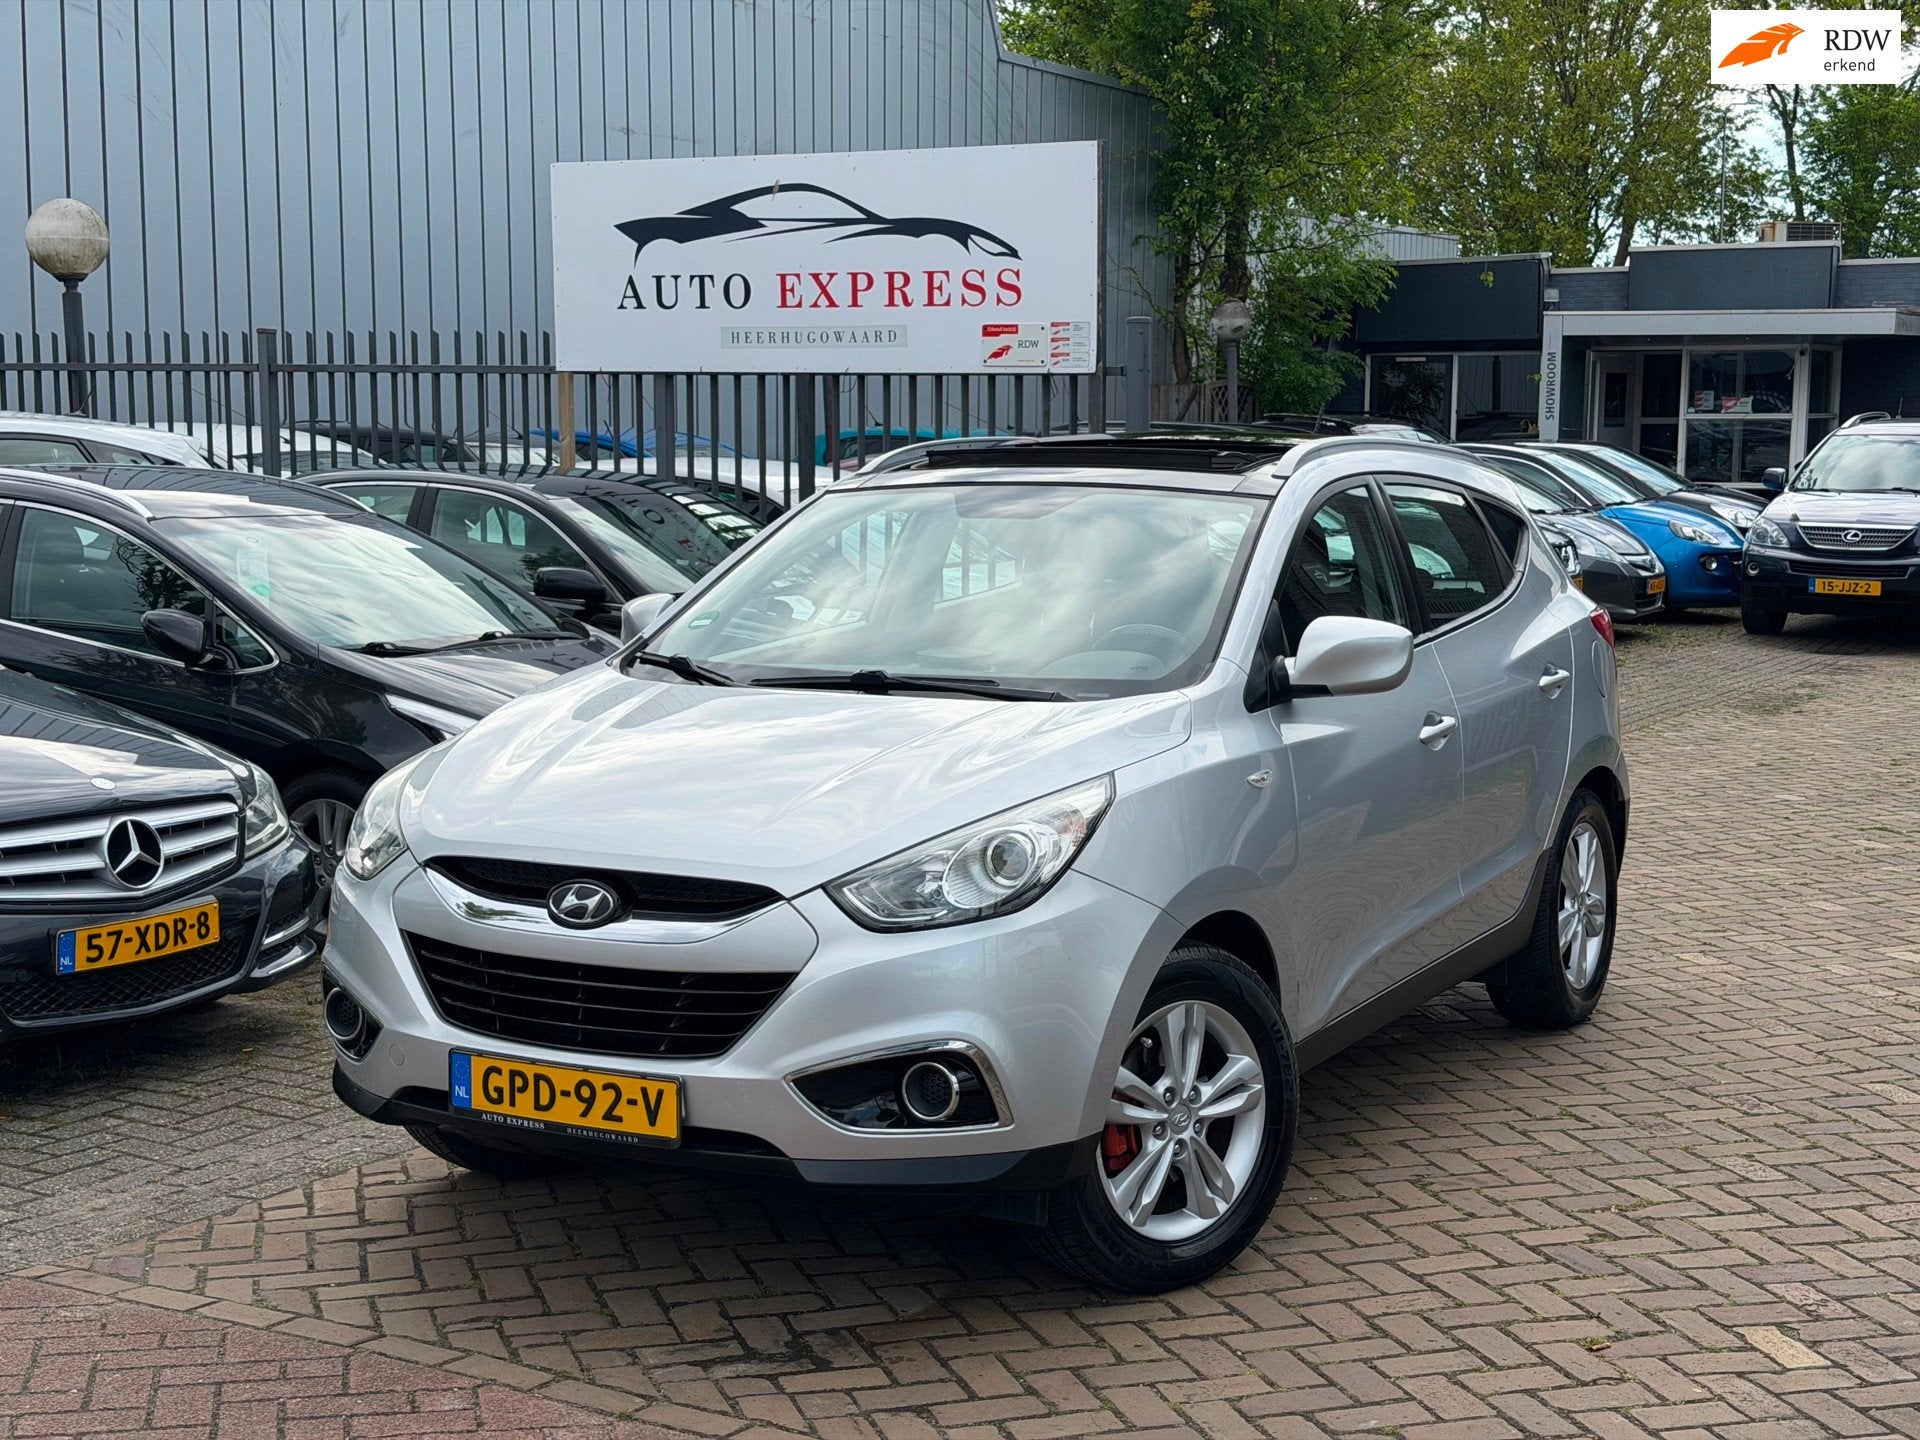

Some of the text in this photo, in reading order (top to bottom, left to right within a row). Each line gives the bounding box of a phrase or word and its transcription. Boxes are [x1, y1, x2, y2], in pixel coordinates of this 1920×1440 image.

[616, 268, 1023, 310] AUTO EXPRESS
[730, 329, 898, 345] HEERHUGOWAARD
[1017, 339, 1039, 349] RDW
[1545, 351, 1557, 421] SHOWROOM
[1822, 581, 1871, 593] 15-JJZ-2
[85, 911, 211, 964] 57-XDR-8
[60, 956, 73, 966] NL
[455, 1085, 469, 1098] NL
[481, 1065, 665, 1128] GPD-92-V
[481, 1113, 545, 1130] AUTO EXPRESS
[566, 1127, 639, 1143] HEERHUGOWAARD
